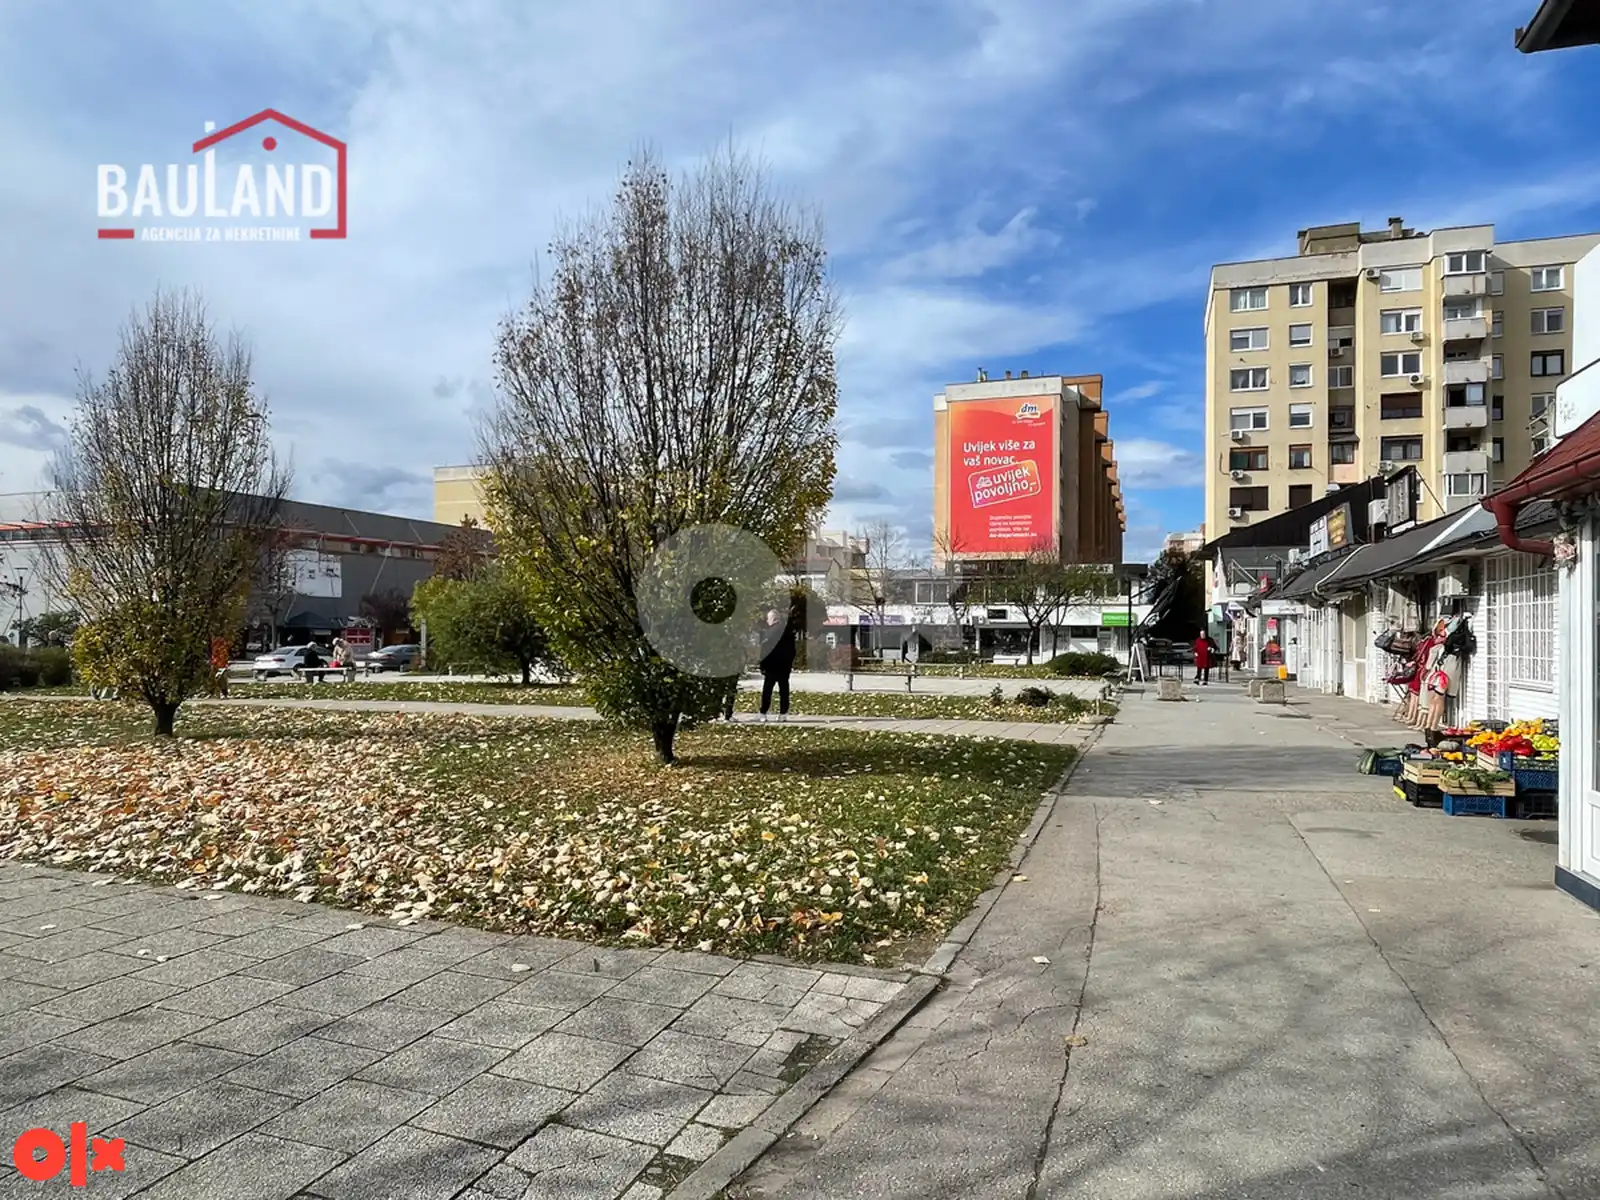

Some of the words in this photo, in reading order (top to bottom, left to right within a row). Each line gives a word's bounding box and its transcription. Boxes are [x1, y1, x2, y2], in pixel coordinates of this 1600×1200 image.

[1021, 403, 1037, 413] dm
[963, 442, 997, 454] Uvijek
[999, 439, 1020, 450] više
[1023, 440, 1035, 450] za
[963, 455, 981, 466] vaš
[992, 466, 1031, 483] uvijek
